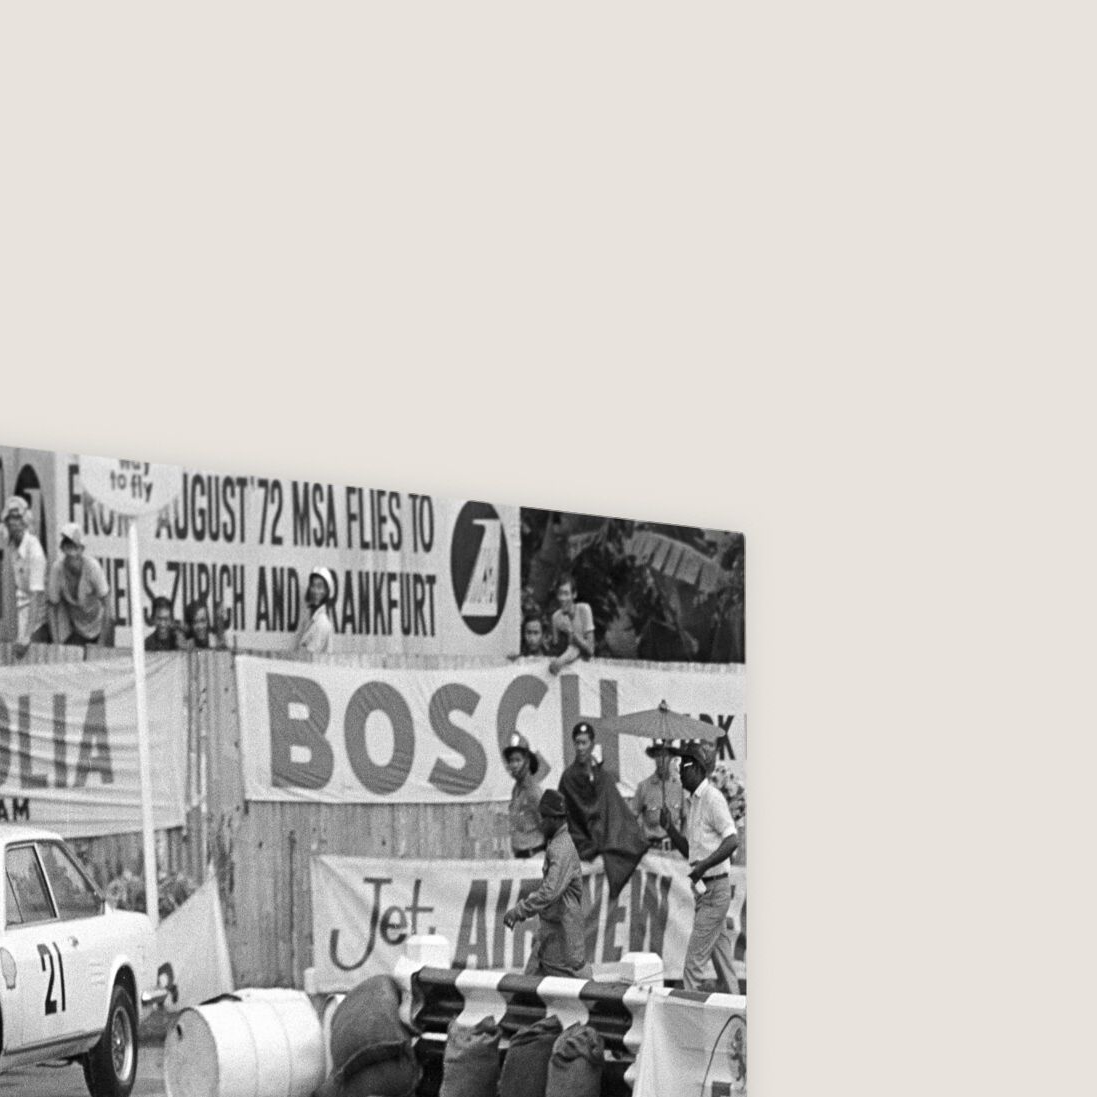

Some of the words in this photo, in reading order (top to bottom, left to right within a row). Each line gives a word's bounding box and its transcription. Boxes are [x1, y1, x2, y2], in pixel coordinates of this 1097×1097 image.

[109, 470, 128, 491] to
[131, 473, 153, 503] fly
[291, 480, 338, 548] MSA
[346, 486, 402, 552] FLIES
[408, 493, 434, 553] TO
[255, 565, 300, 632] AND
[325, 568, 437, 637] RANKFURT
[266, 672, 618, 796] BOSCH
[37, 941, 66, 1015] 21
